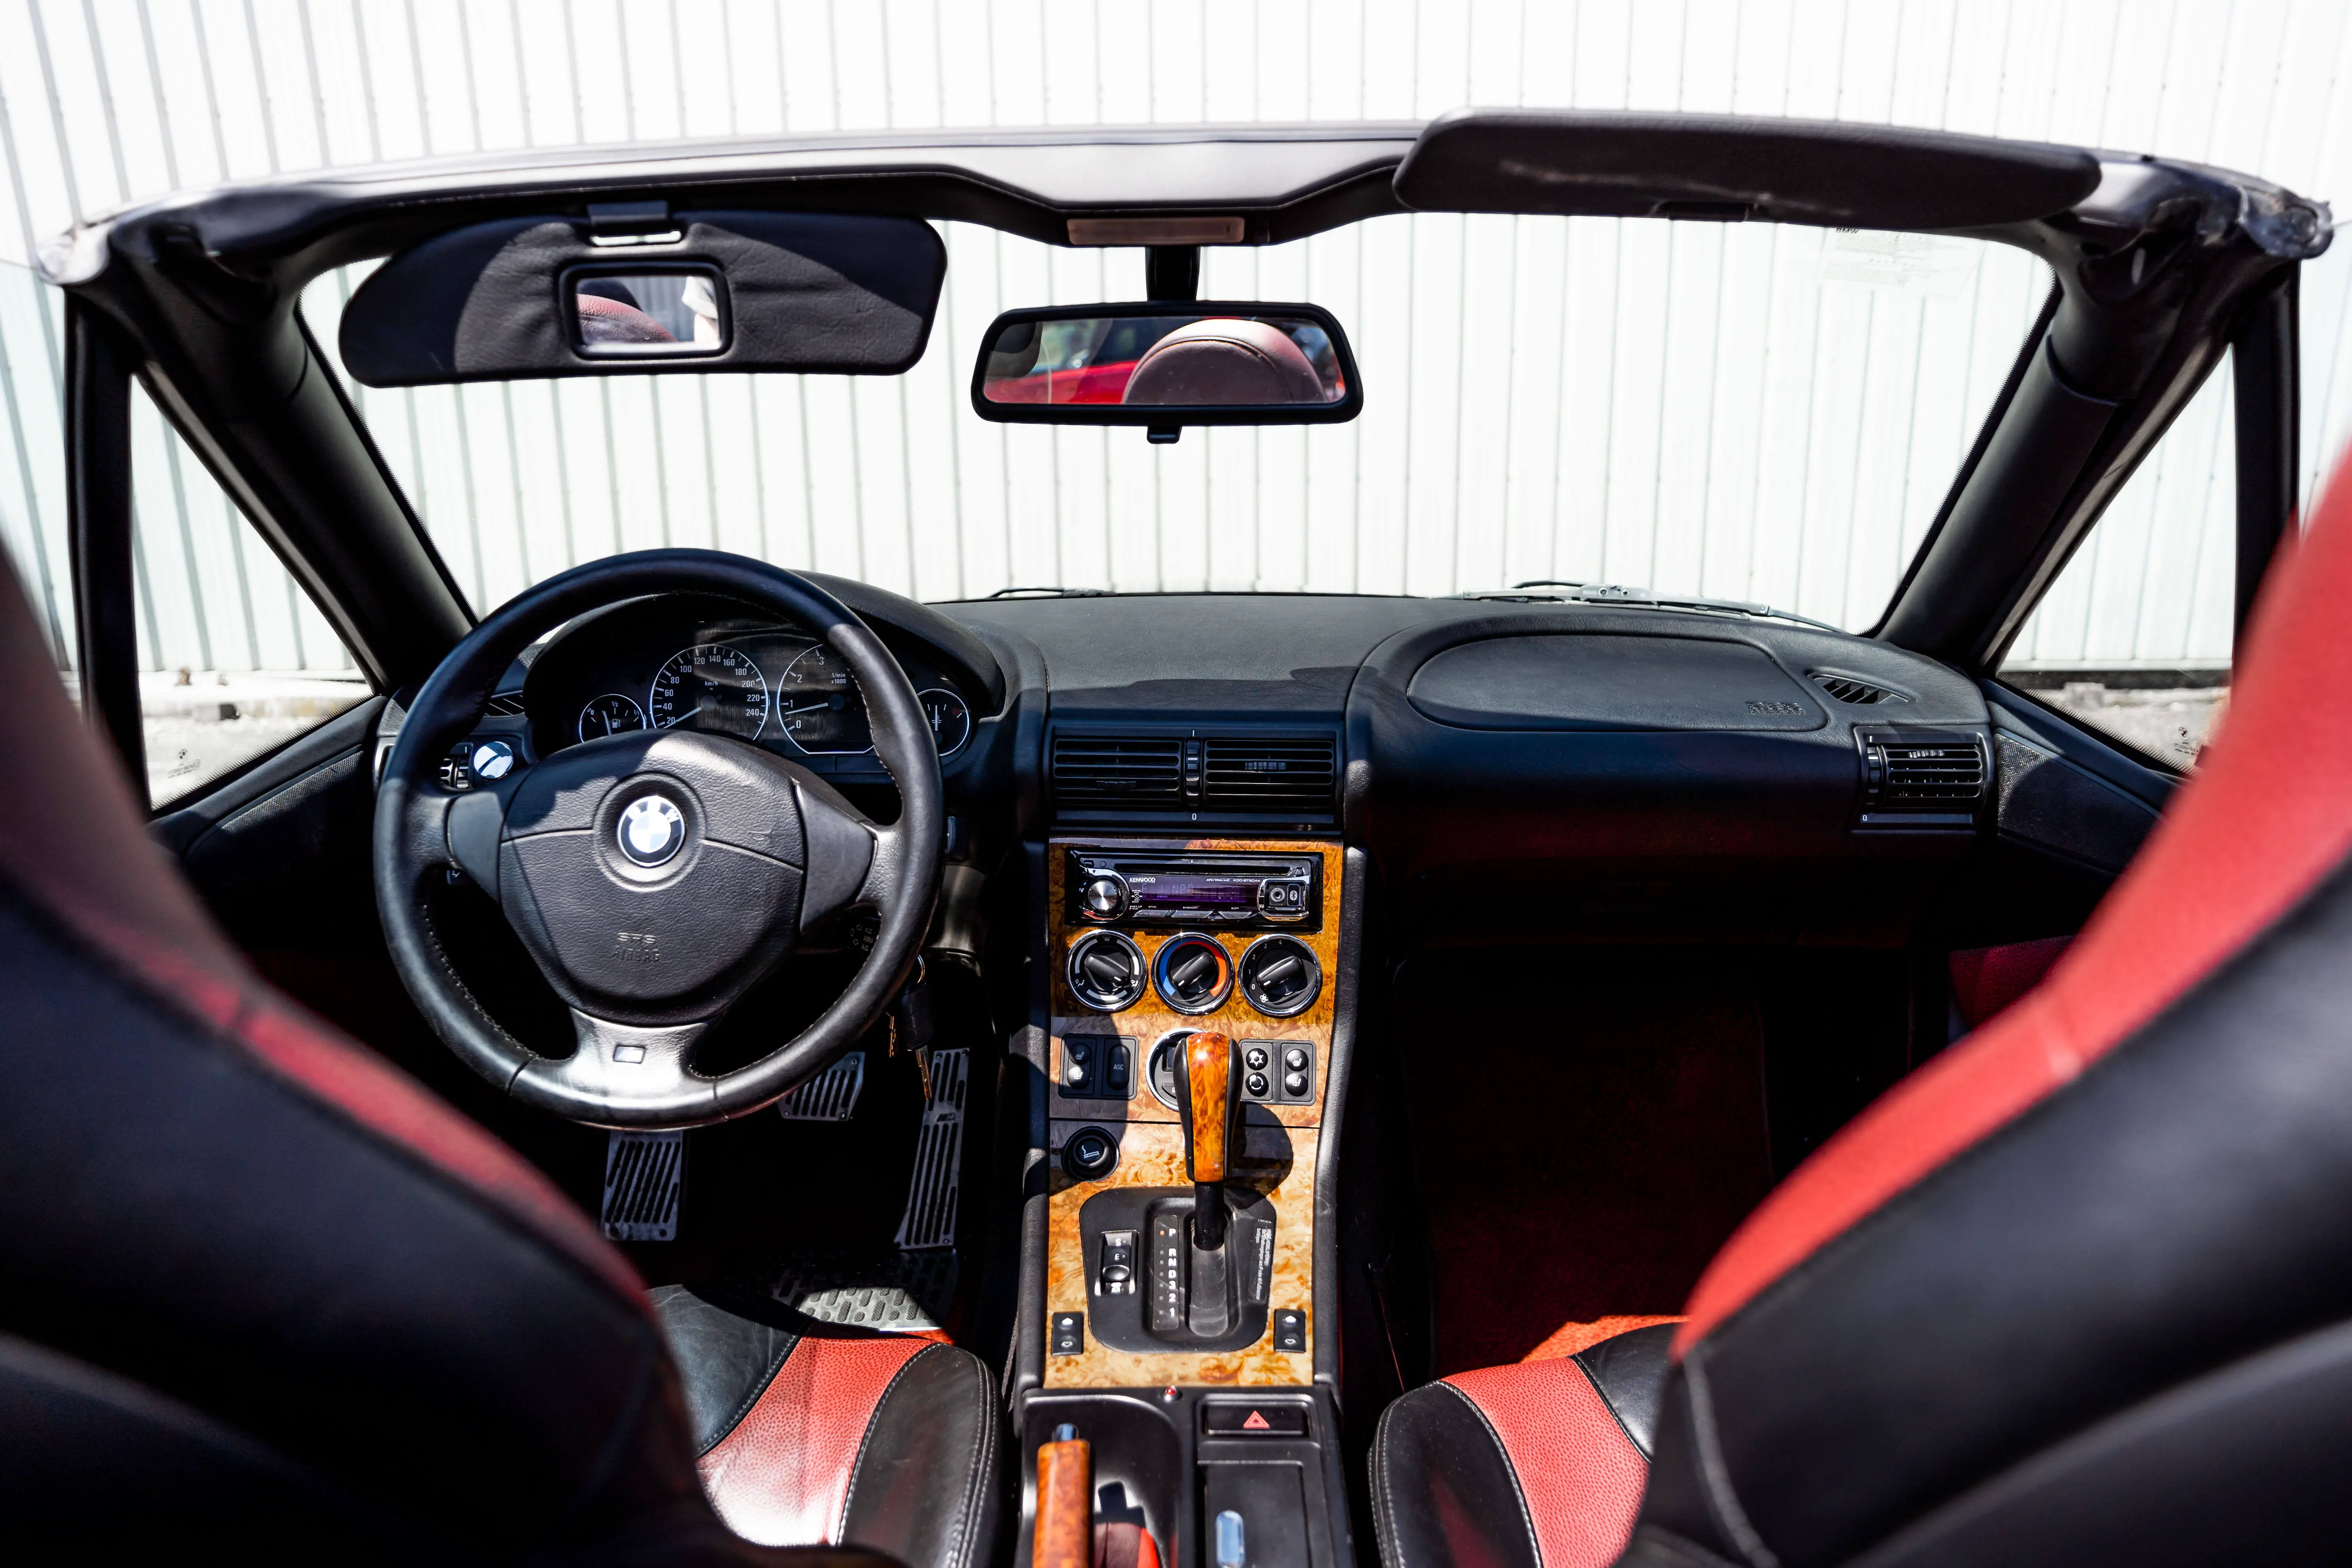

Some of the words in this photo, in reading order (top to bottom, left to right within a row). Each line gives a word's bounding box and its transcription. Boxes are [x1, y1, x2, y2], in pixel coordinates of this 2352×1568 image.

[819, 657, 824, 665] 3
[797, 674, 802, 683] 2
[790, 699, 793, 708] 1
[796, 720, 801, 728] 0
[617, 932, 656, 943] SRS
[1169, 1228, 1176, 1237] P
[1115, 1238, 1121, 1246] S
[1169, 1248, 1176, 1256] R
[1168, 1258, 1177, 1266] N
[1168, 1270, 1176, 1278] D
[1168, 1281, 1176, 1289] 3
[1168, 1293, 1176, 1302] 2
[1169, 1307, 1175, 1317] 1
